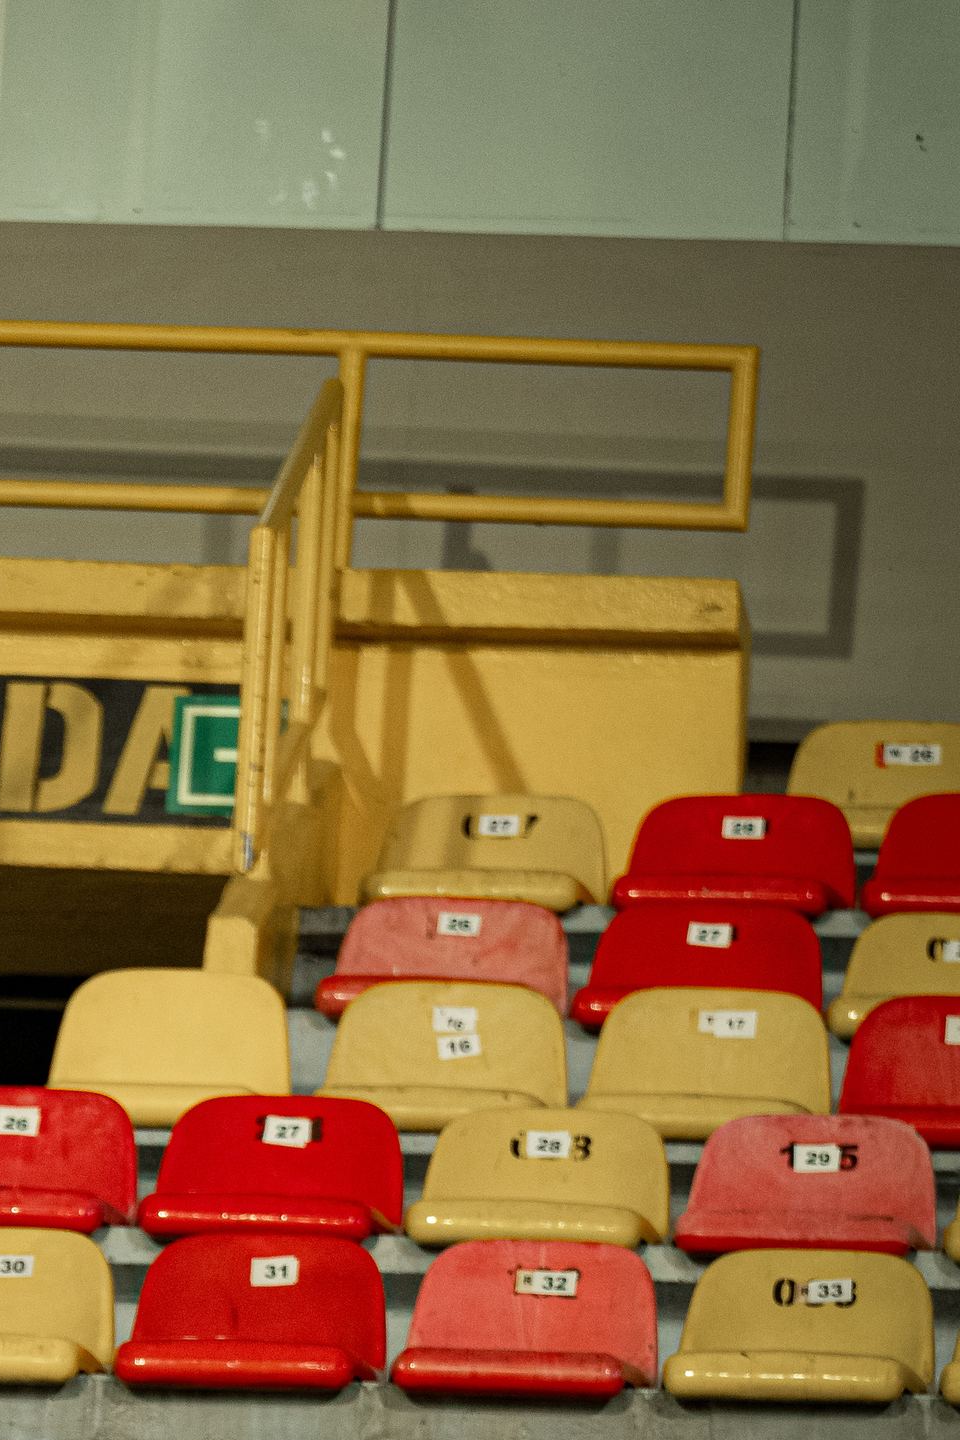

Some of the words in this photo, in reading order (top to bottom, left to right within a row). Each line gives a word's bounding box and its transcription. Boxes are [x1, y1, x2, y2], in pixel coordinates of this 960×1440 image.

[4, 1117, 28, 1132] 26
[276, 1125, 300, 1139] 27
[0, 1260, 26, 1274] 30
[265, 1265, 288, 1279] 31
[542, 1276, 567, 1292] 32
[818, 1283, 843, 1299] 33
